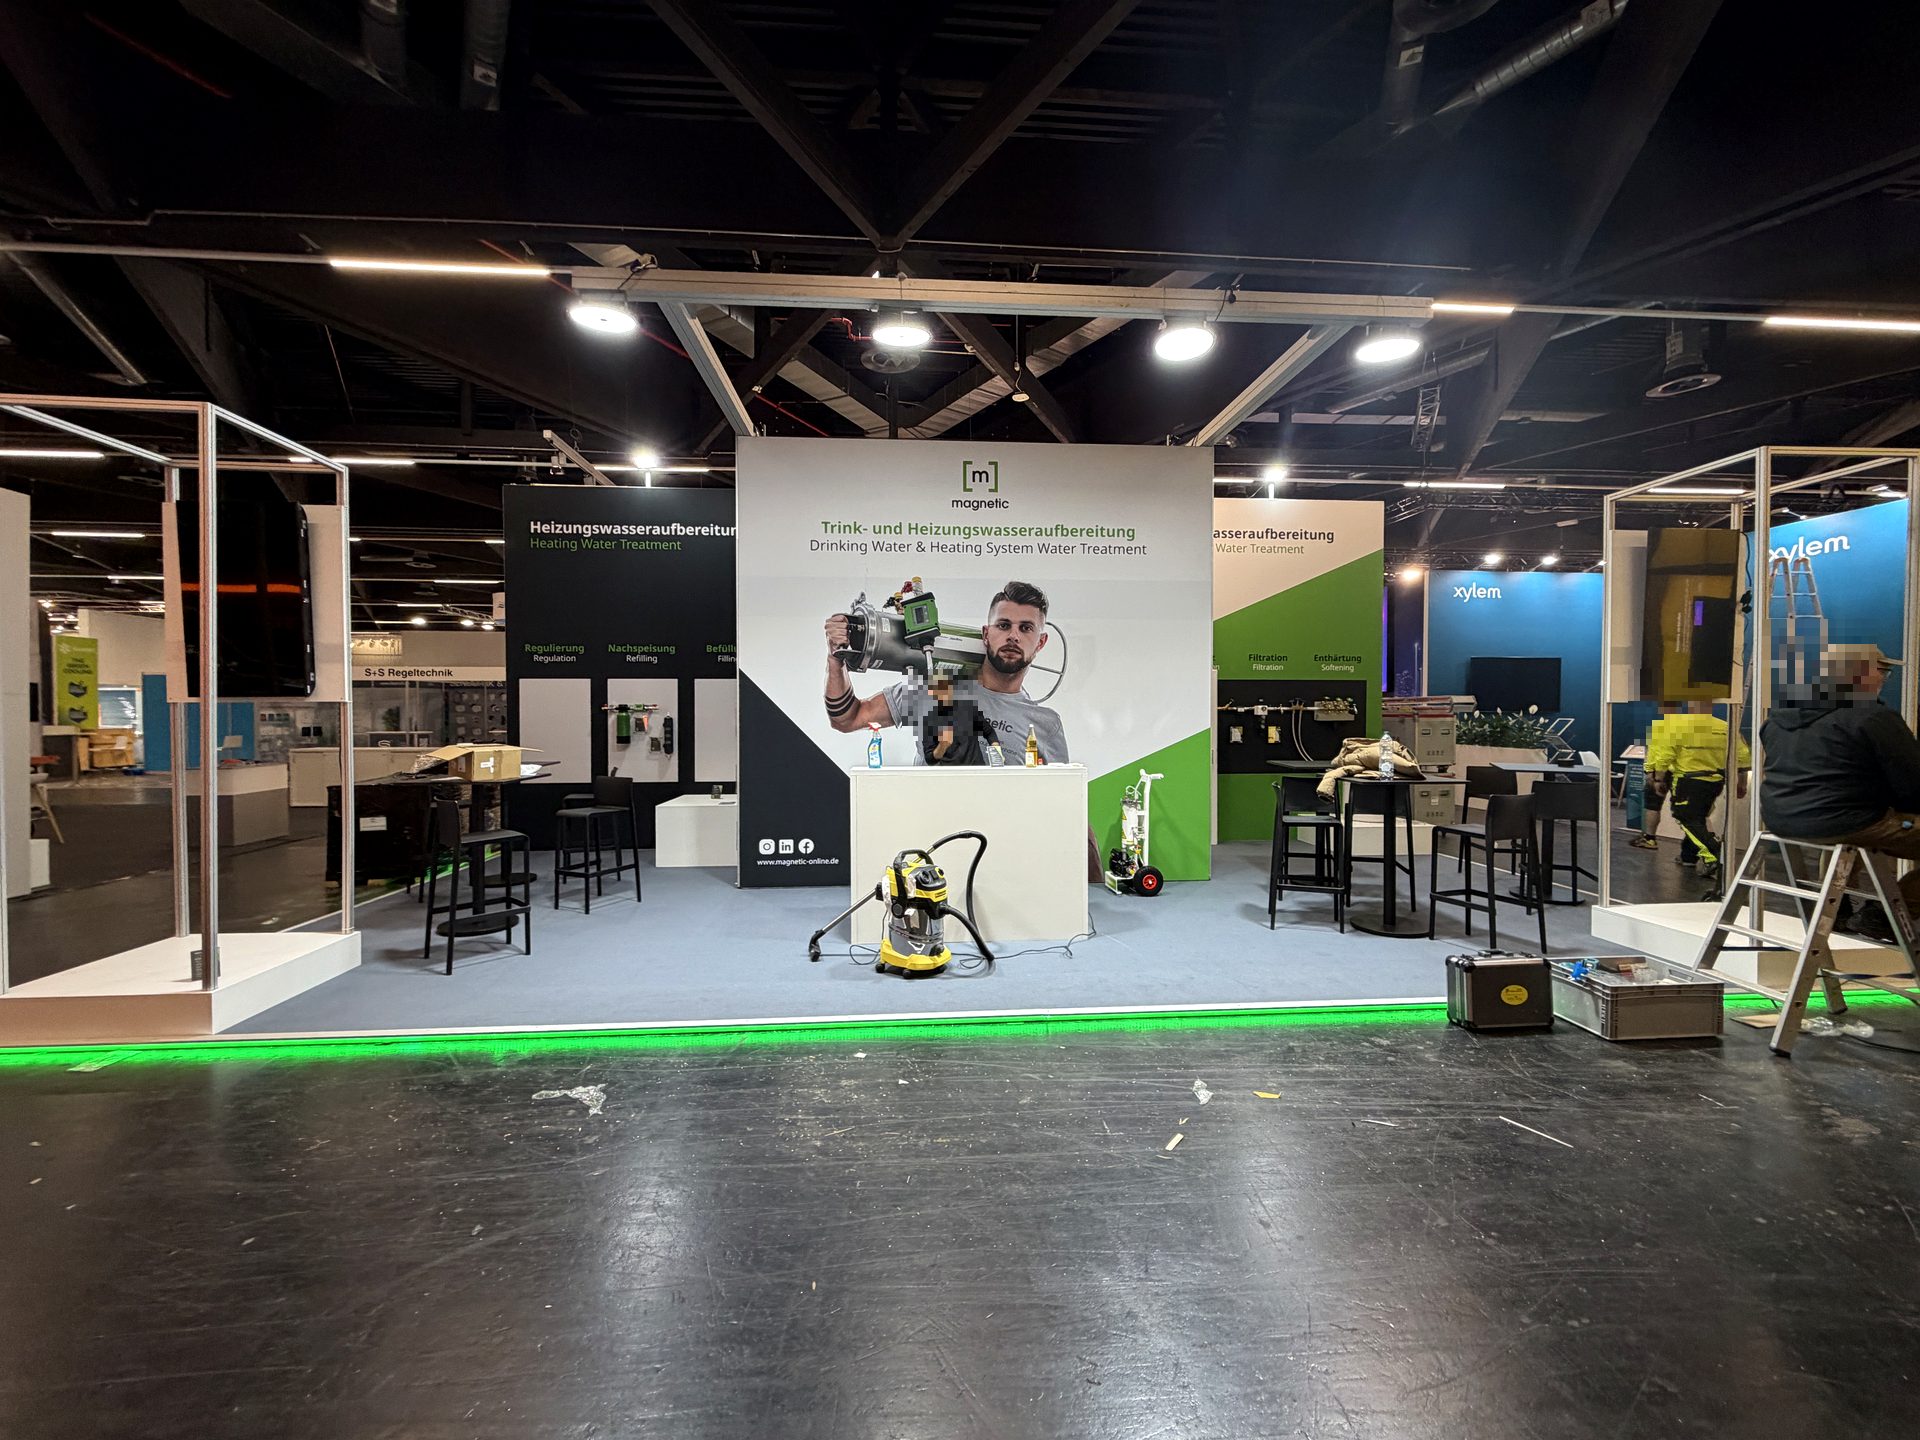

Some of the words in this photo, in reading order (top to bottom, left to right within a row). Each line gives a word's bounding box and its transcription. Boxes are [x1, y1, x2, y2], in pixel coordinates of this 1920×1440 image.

[951, 498, 1010, 511] magnetic
[821, 521, 868, 535] Trink-
[872, 522, 902, 535] und
[908, 522, 1136, 541] Heizungswasseraufbereitung
[530, 538, 578, 551] Heating
[580, 538, 616, 549] Water
[620, 539, 682, 550] Treatment
[810, 539, 868, 555] Drinking
[872, 540, 912, 553] Water
[916, 541, 926, 553] &
[930, 541, 982, 556] Heating
[986, 542, 1033, 556] System
[1037, 543, 1076, 554] Water
[1080, 543, 1147, 555] Treatment
[1215, 543, 1247, 553] Water
[1250, 543, 1304, 554] Treatment
[1768, 535, 1850, 563] xylem
[1453, 582, 1502, 602] xylem
[524, 643, 585, 654] Regulierung
[608, 644, 676, 655] Nachspeisung
[533, 654, 577, 663] Regulation
[626, 654, 658, 664] Refilling
[1248, 653, 1288, 662] Filtration
[1313, 653, 1362, 663] Enthärtung
[1252, 663, 1284, 671] Filtration
[1321, 663, 1355, 673] Softening
[364, 668, 385, 677] S+S
[388, 668, 453, 679] Regeltechnik
[756, 858, 839, 867] www.magnetic-online.de
